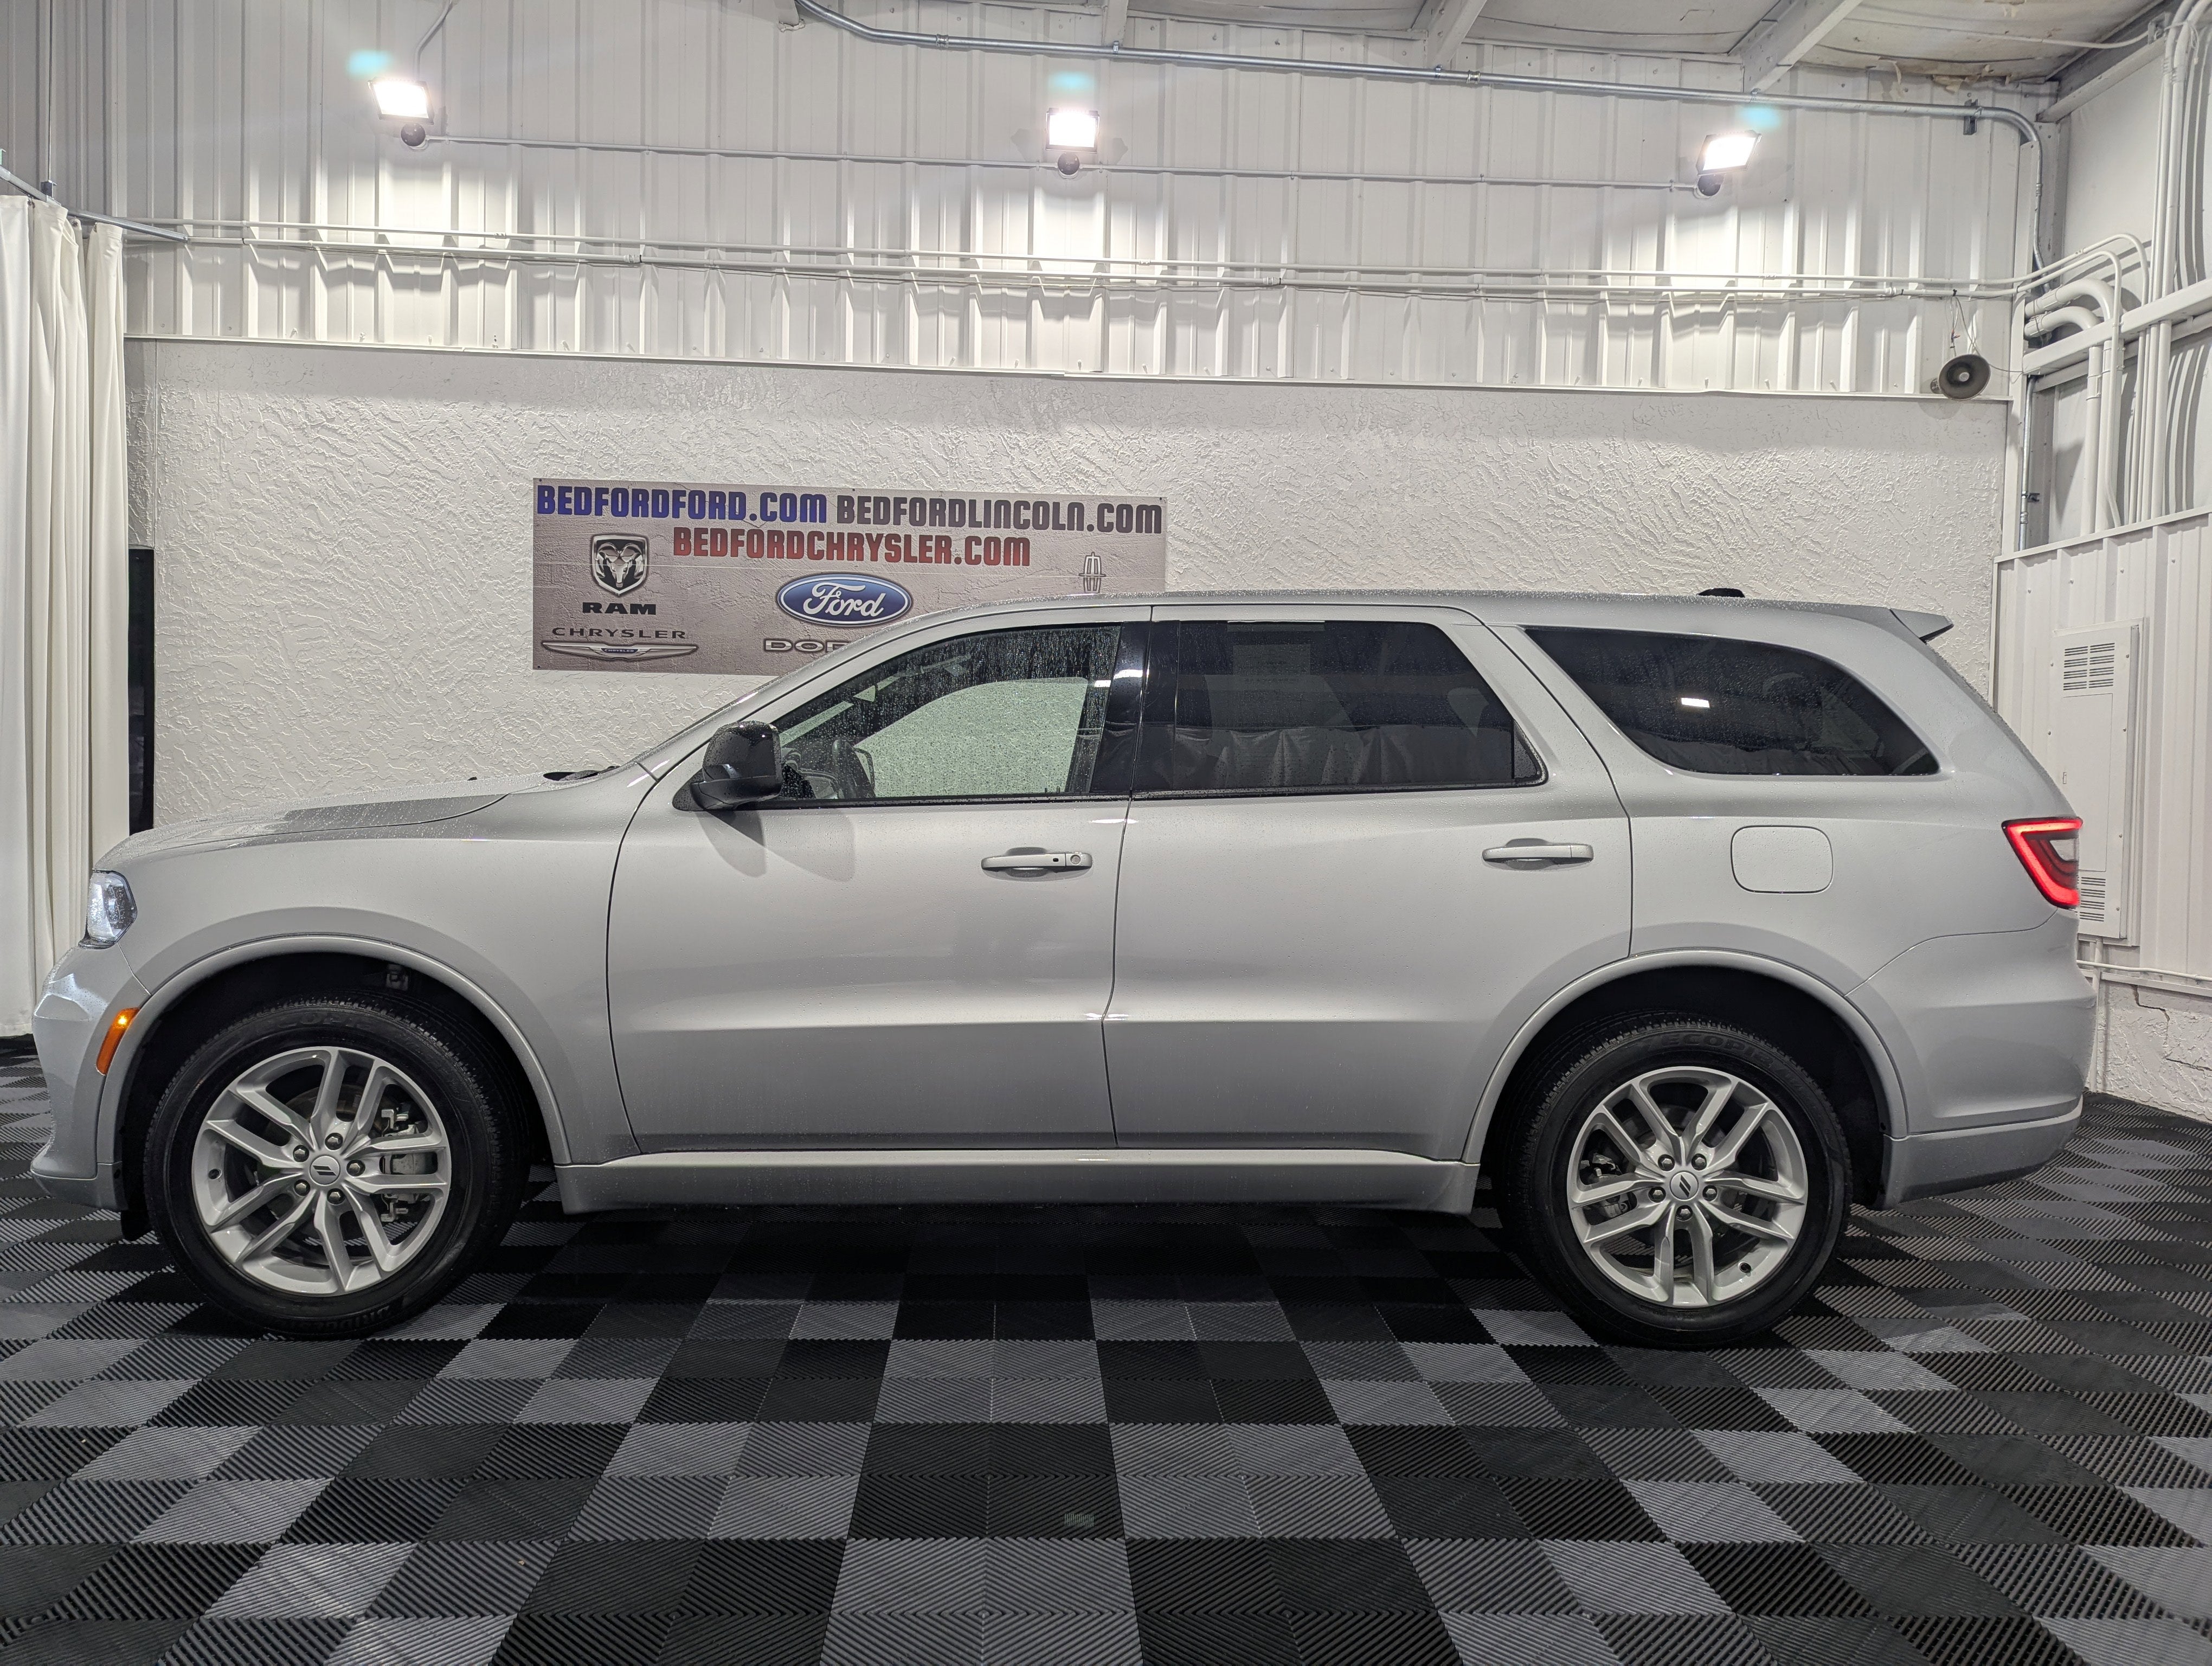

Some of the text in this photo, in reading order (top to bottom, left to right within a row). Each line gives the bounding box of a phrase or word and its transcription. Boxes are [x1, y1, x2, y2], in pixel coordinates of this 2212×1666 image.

[537, 485, 1162, 534] BEDFORDFORD.COM BEDFORDLINCOLN.COM
[673, 527, 1030, 567] BEDFORDCHRYSLER.COM
[582, 602, 656, 615] RAM
[802, 581, 885, 617] Ford
[552, 627, 686, 639] CHRYSLER
